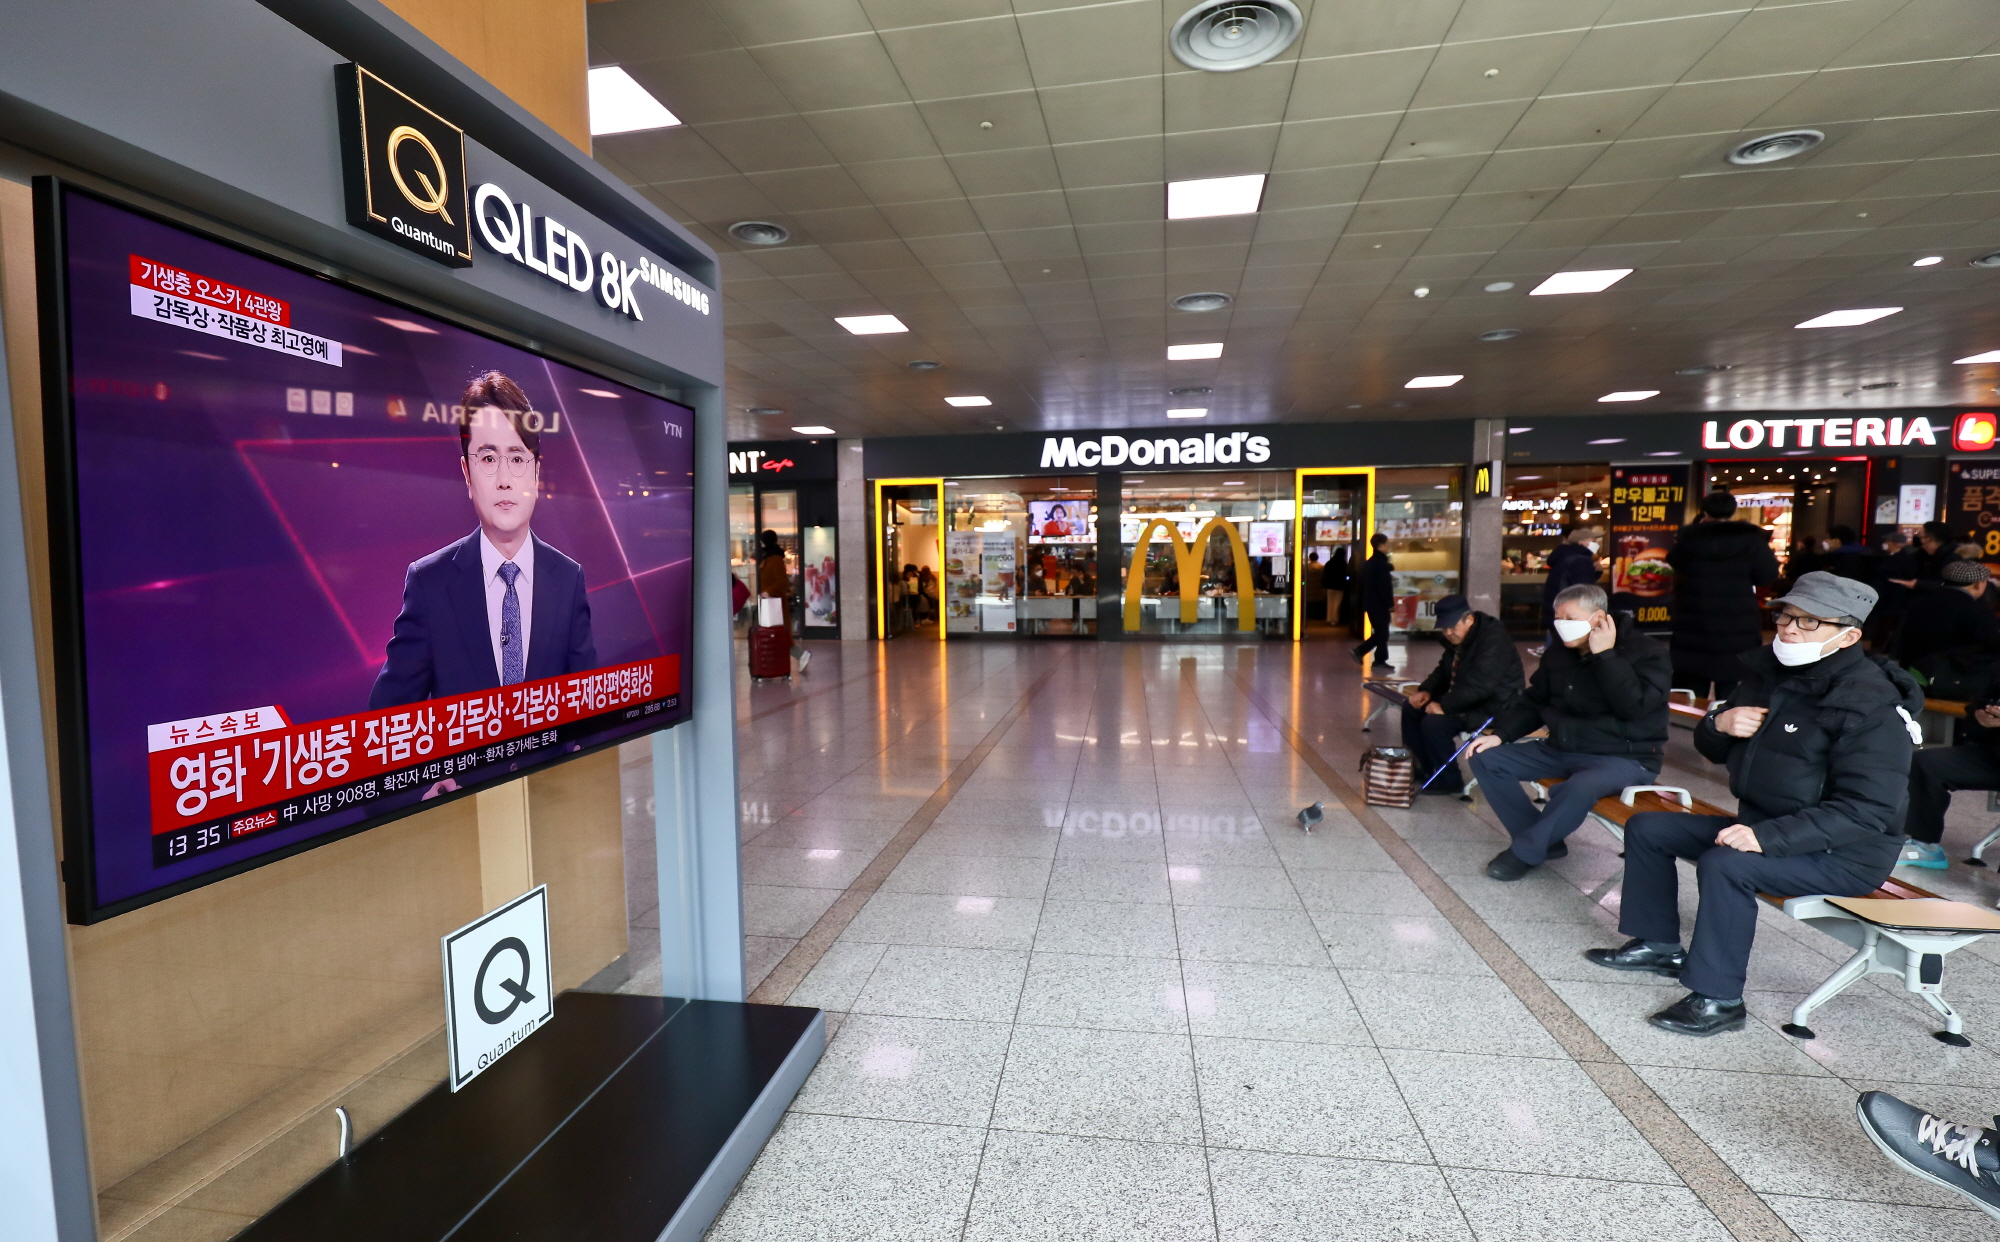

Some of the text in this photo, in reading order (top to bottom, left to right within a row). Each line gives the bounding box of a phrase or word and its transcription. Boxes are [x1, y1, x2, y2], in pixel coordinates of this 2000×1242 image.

[387, 125, 455, 226] Q
[391, 216, 455, 257] Quantum
[474, 182, 644, 322] QLED 8K
[140, 261, 282, 322] 기생충 오스카 4관왕
[638, 256, 709, 316] SAMSUNG
[270, 327, 329, 360] 최고영예
[663, 420, 683, 439] YTN
[1039, 431, 1271, 468] McDonald's
[1702, 417, 1937, 450] LOTTERIA
[169, 711, 261, 745] 뉴스속보
[169, 744, 247, 817] 영화
[253, 719, 357, 790] '기생충'
[283, 804, 298, 822] 中
[302, 793, 333, 816] 사망
[336, 780, 380, 808] 908명,
[383, 768, 420, 792] 확진자
[422, 762, 441, 780] 4만
[443, 758, 454, 775] 명
[505, 735, 540, 757] 증가세는
[541, 730, 558, 746] 둔화
[169, 825, 221, 857] 13 35
[233, 812, 277, 836] 주요뉴스
[473, 936, 536, 1025] Q
[477, 1018, 535, 1070] Quantum
